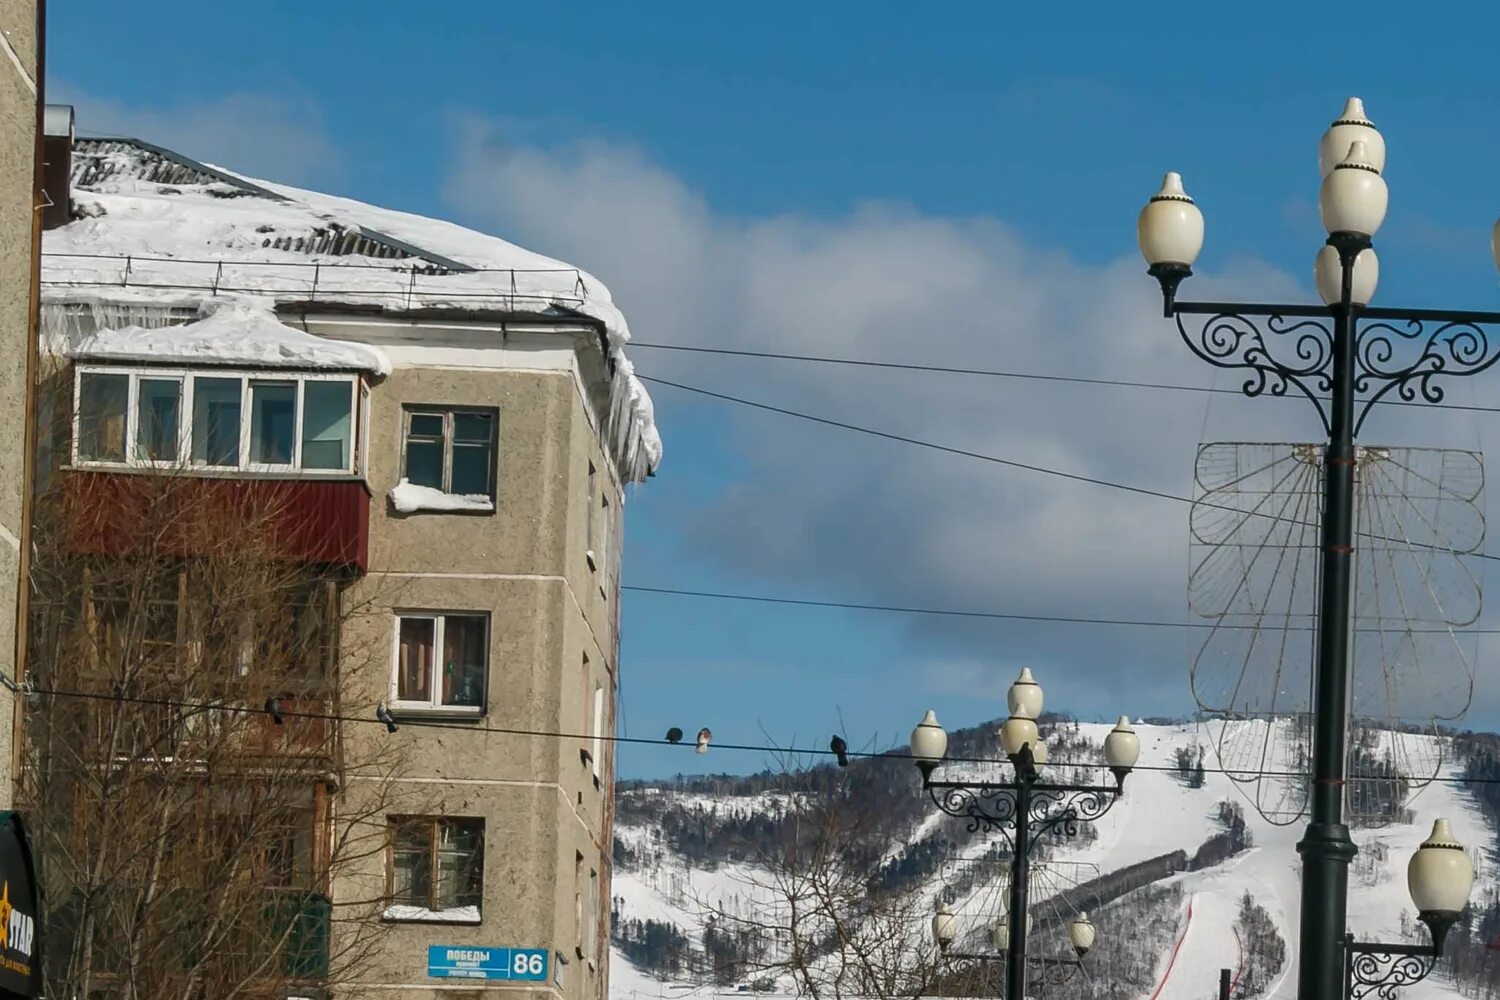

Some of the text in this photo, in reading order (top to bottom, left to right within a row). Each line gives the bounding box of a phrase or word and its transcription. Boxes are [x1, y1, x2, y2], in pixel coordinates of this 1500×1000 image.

[9, 908, 33, 957] STAR
[446, 950, 543, 974] ПОБЕДЫ 86
